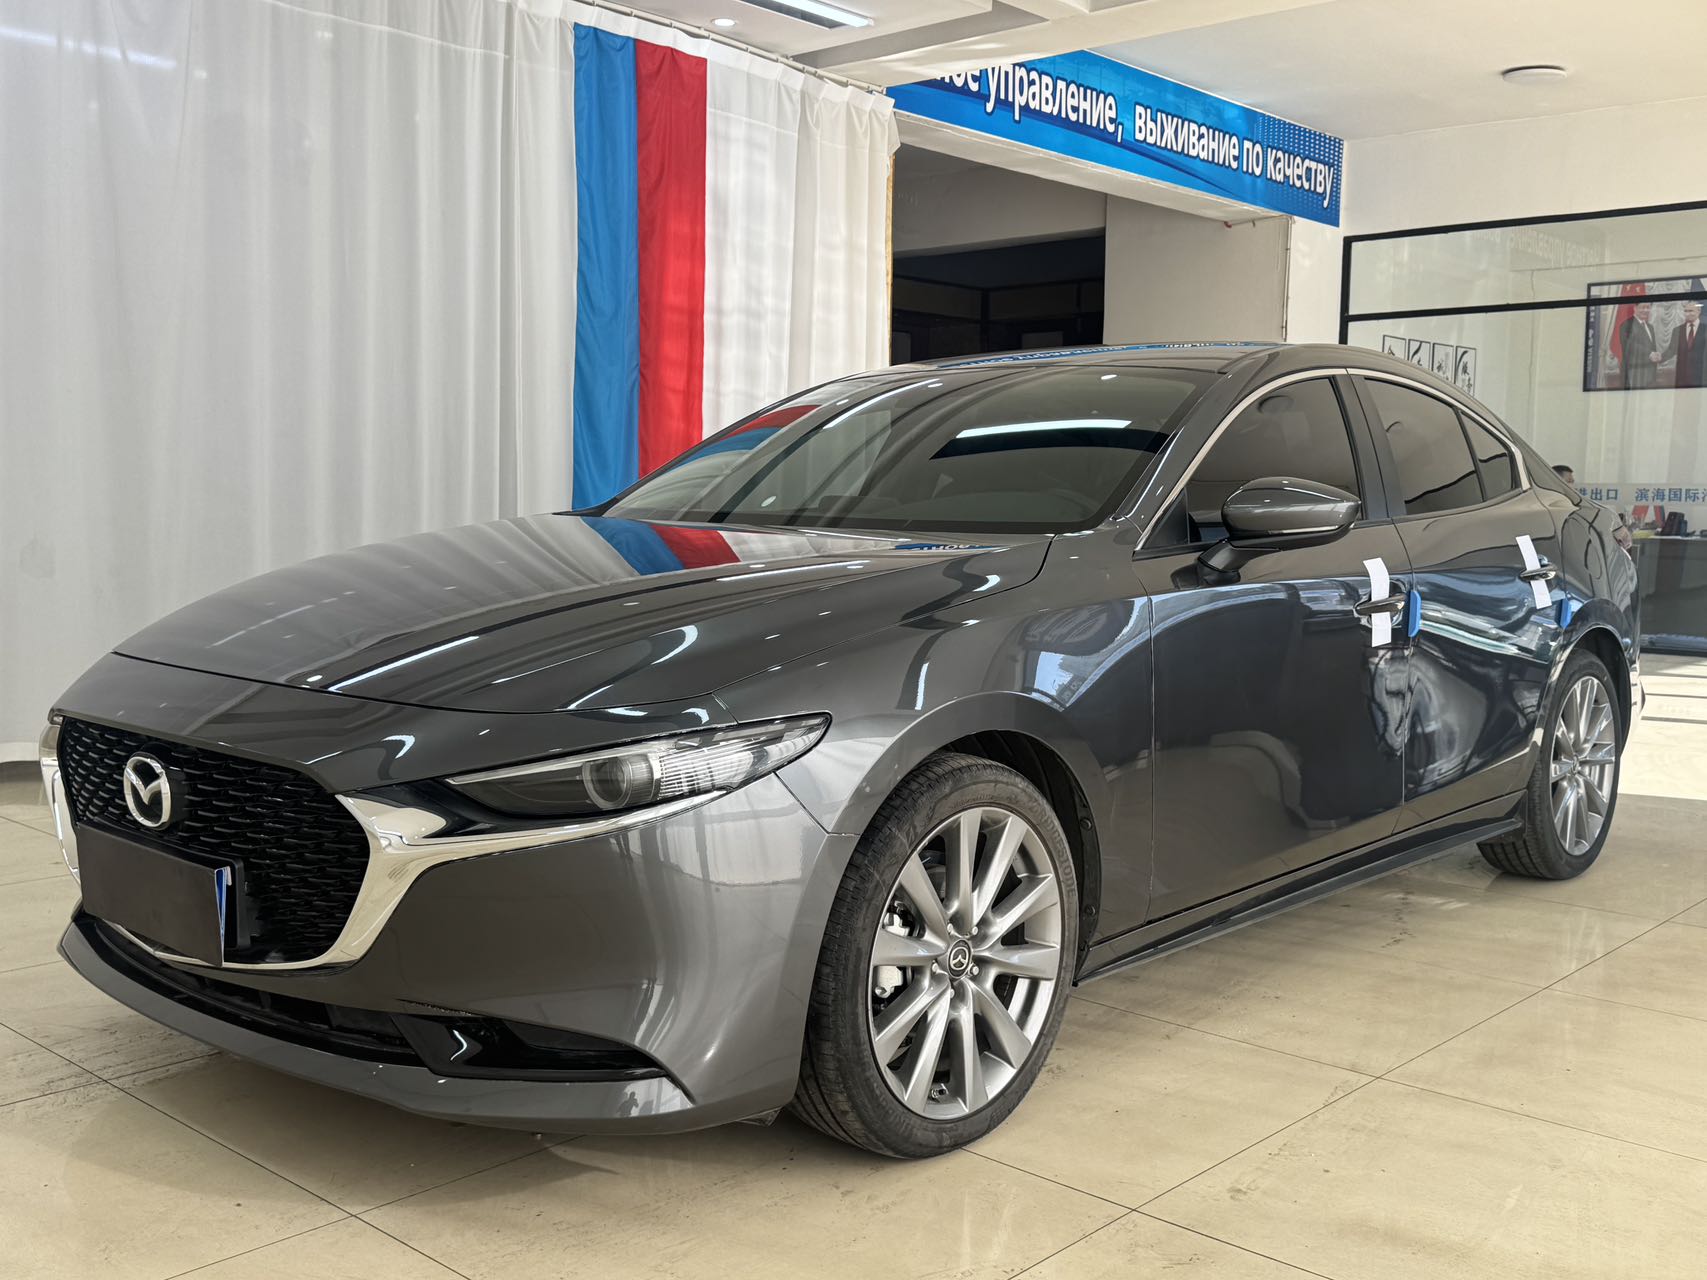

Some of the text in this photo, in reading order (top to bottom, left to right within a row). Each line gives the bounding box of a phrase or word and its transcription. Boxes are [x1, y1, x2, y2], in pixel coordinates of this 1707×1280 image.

[986, 65, 1123, 143] управление,
[1134, 104, 1239, 170] выживание
[1242, 139, 1263, 177] по
[1266, 147, 1334, 208] качеству
